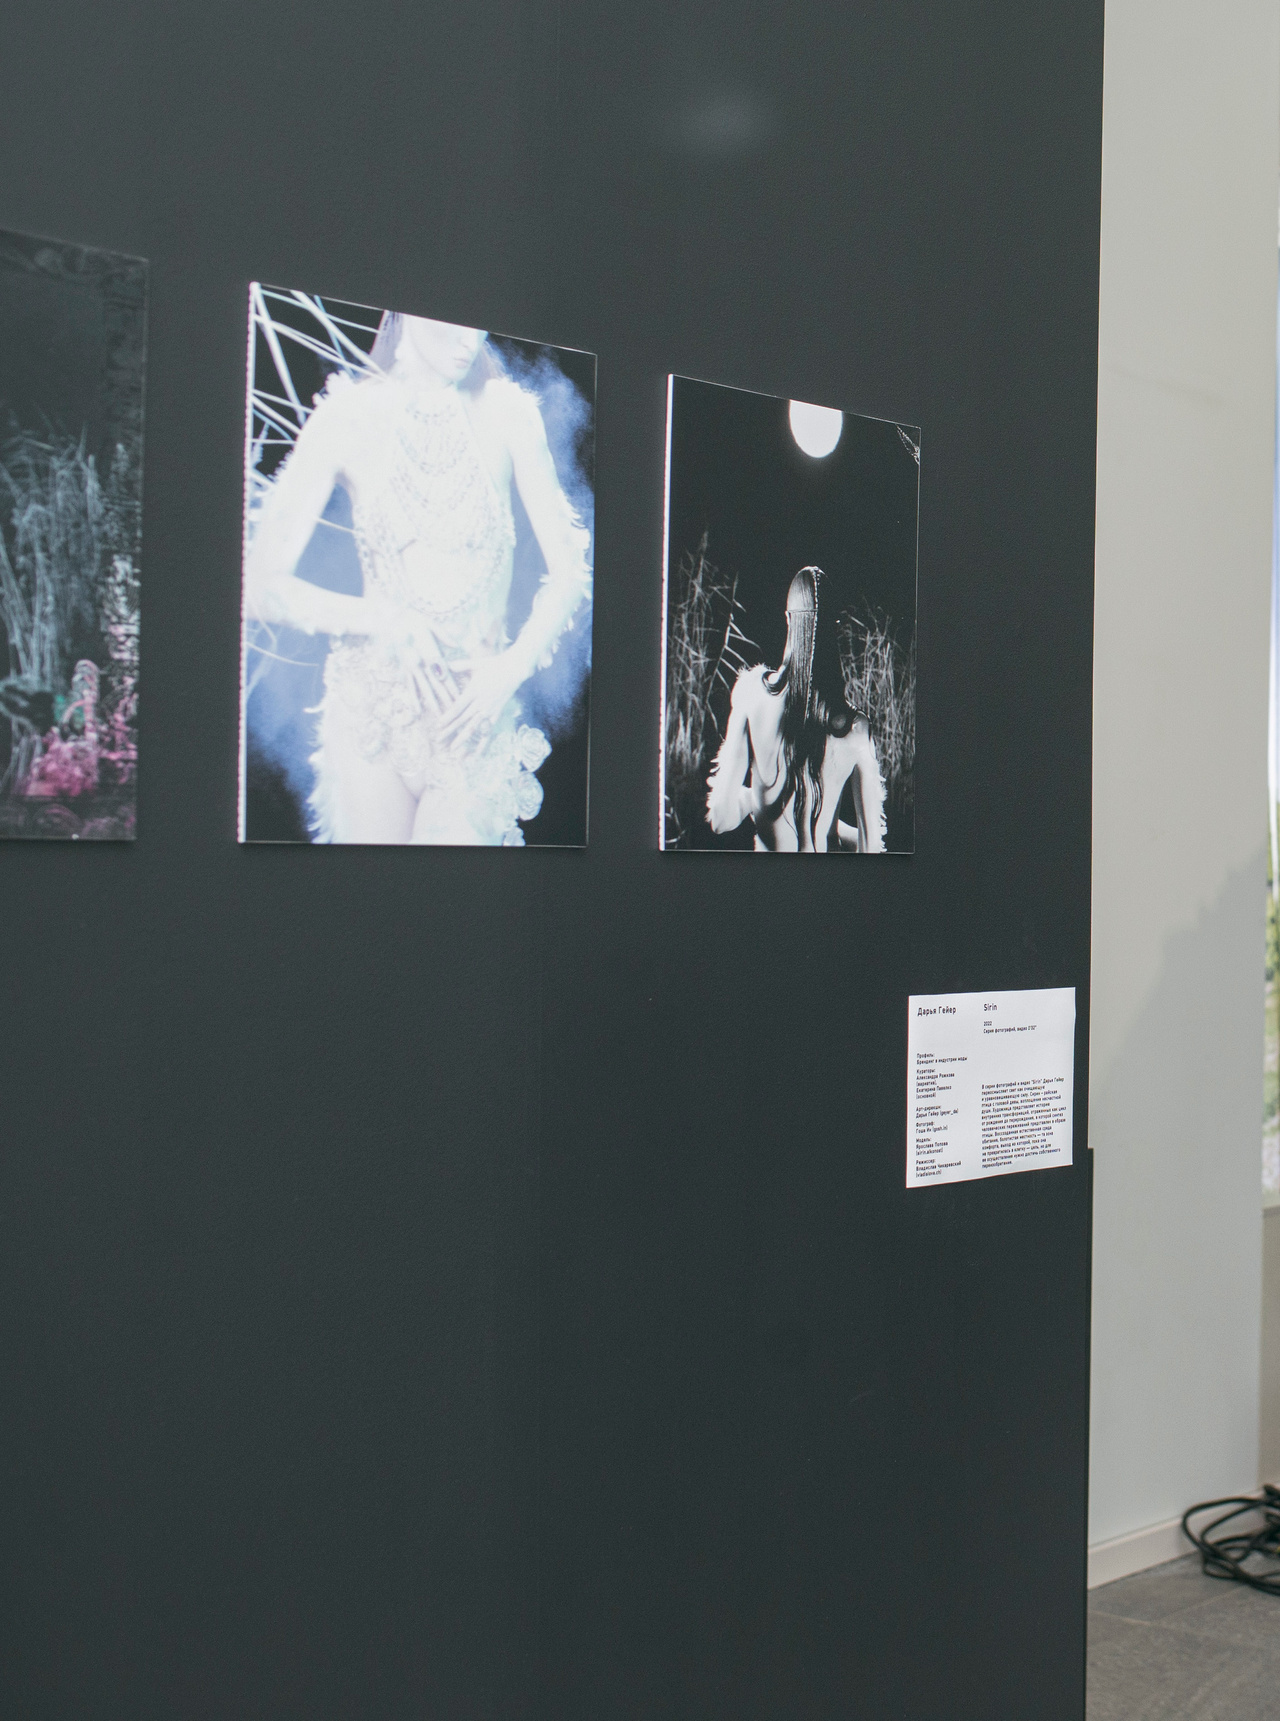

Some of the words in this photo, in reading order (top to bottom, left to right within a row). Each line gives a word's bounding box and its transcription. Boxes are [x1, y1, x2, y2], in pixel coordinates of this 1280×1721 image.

[917, 1007, 937, 1017] Дарья
[939, 1006, 956, 1015] Гейер
[984, 1003, 997, 1011] Sirin
